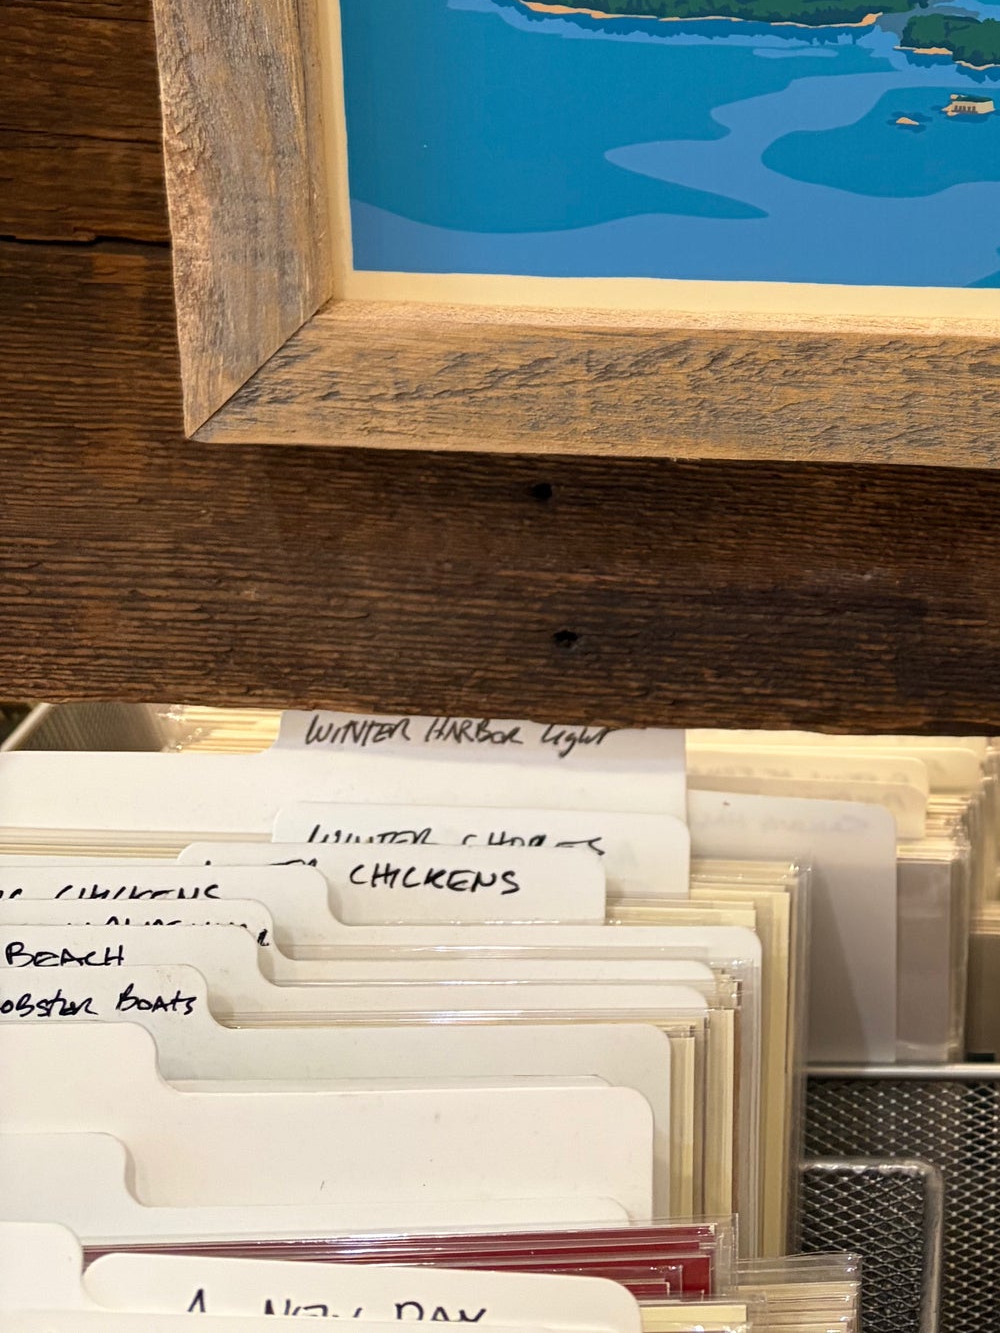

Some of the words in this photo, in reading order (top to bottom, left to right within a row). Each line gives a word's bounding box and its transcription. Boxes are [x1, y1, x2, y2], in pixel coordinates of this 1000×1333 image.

[305, 715, 411, 746] WINTER
[424, 717, 524, 744] HARBOR
[349, 863, 520, 895] CHICKENS
[3, 938, 128, 967] BEACH
